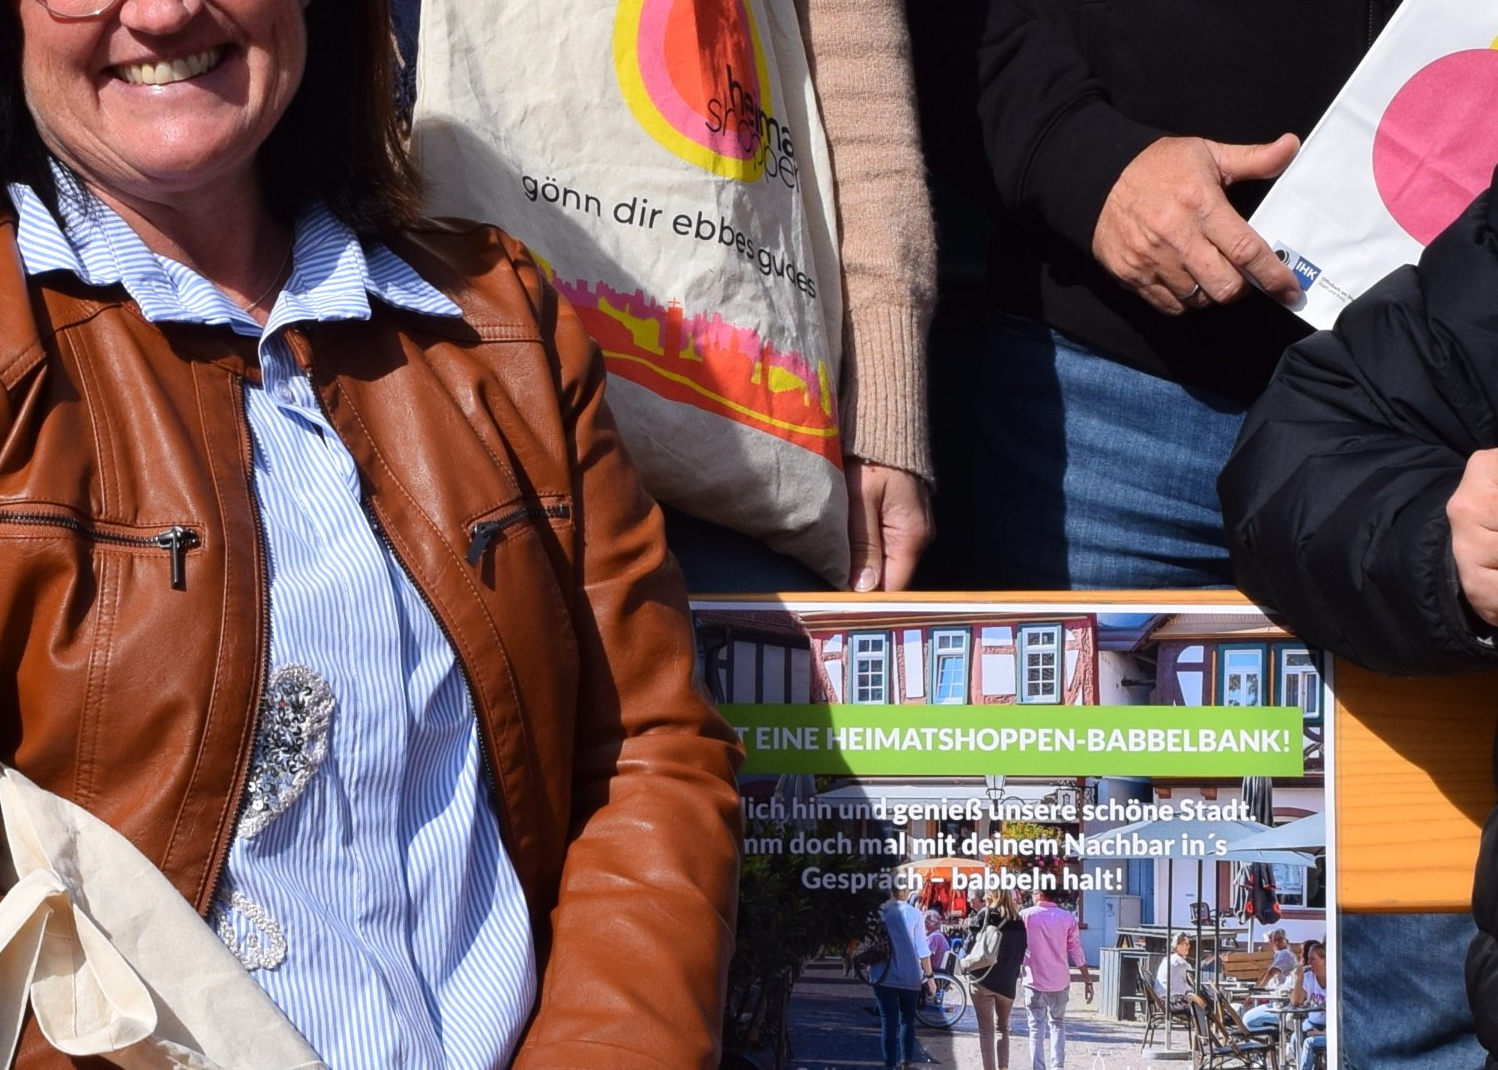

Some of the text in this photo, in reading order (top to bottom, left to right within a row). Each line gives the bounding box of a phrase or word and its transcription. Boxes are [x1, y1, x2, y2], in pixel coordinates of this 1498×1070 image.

[521, 174, 816, 298] gönn dir ebbes gudes
[1296, 261, 1318, 281] IHK
[757, 727, 819, 750] EINE
[826, 727, 1290, 753] HEIMATSHOPPEN-BABBELBANK!
[792, 797, 832, 821] hin
[838, 797, 887, 821] und
[892, 797, 982, 825] genieß
[989, 802, 1078, 821] unsere
[1083, 798, 1174, 821] schöne
[1180, 798, 1257, 822] Stadt.
[790, 832, 852, 855] doch
[859, 832, 906, 855] mal
[912, 832, 956, 856] mit
[961, 832, 1058, 856] deinem
[1065, 833, 1175, 856] Nachbar
[801, 866, 923, 894] Gespräch
[952, 866, 1056, 891] babbeln
[1064, 867, 1123, 891] halt!
